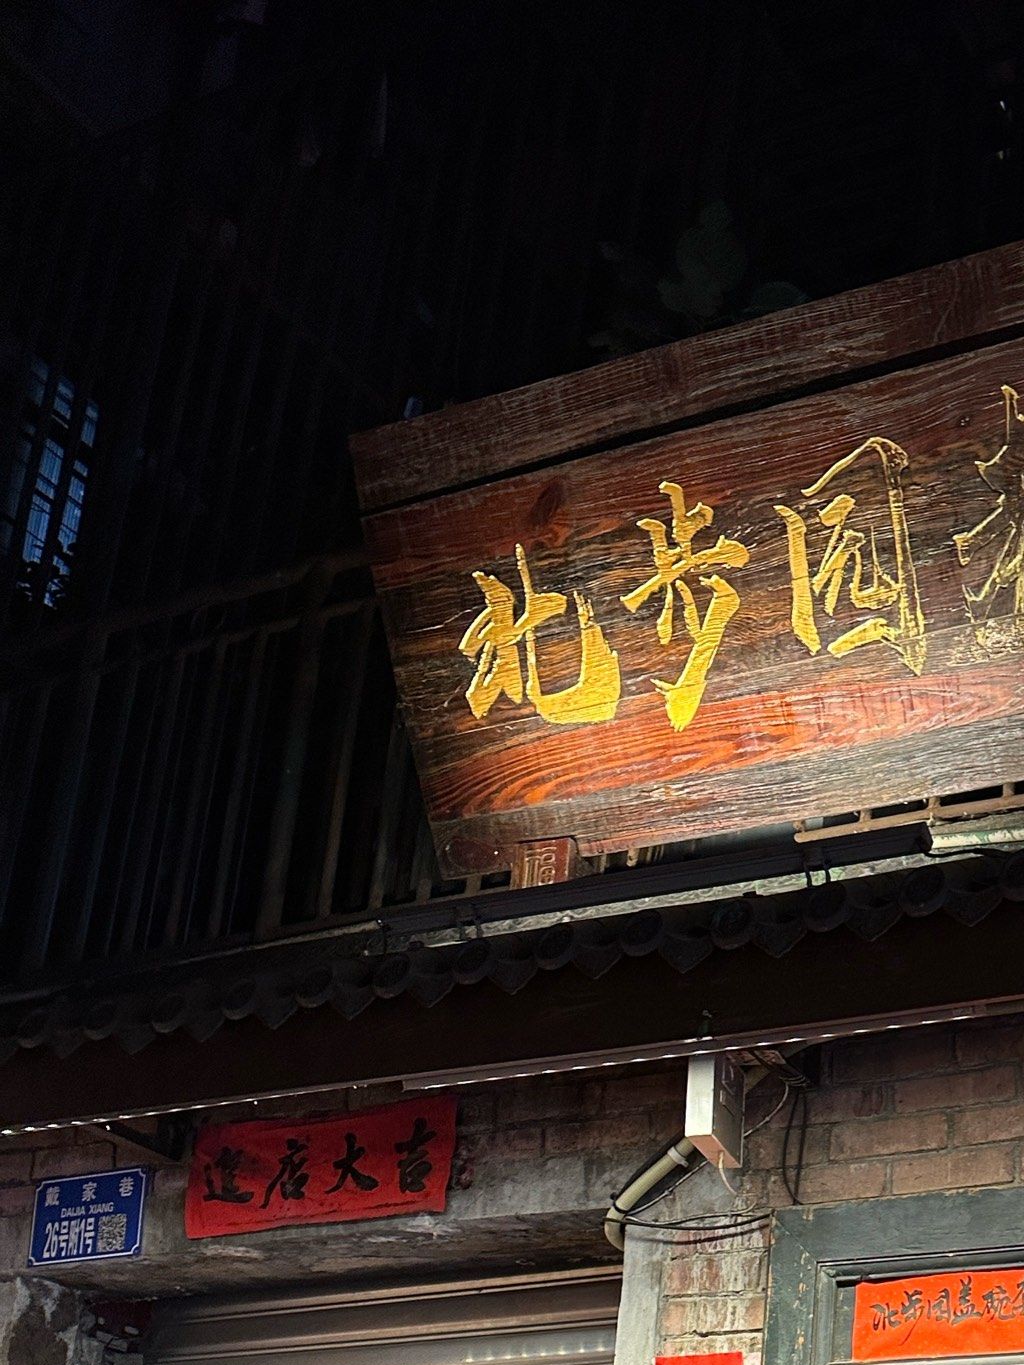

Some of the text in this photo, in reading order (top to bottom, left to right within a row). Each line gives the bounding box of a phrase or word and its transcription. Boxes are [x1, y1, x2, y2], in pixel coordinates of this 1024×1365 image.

[45, 1177, 134, 1207] 戴家巷
[88, 1202, 114, 1215] XIANG
[43, 1217, 95, 1259] 26号附1号
